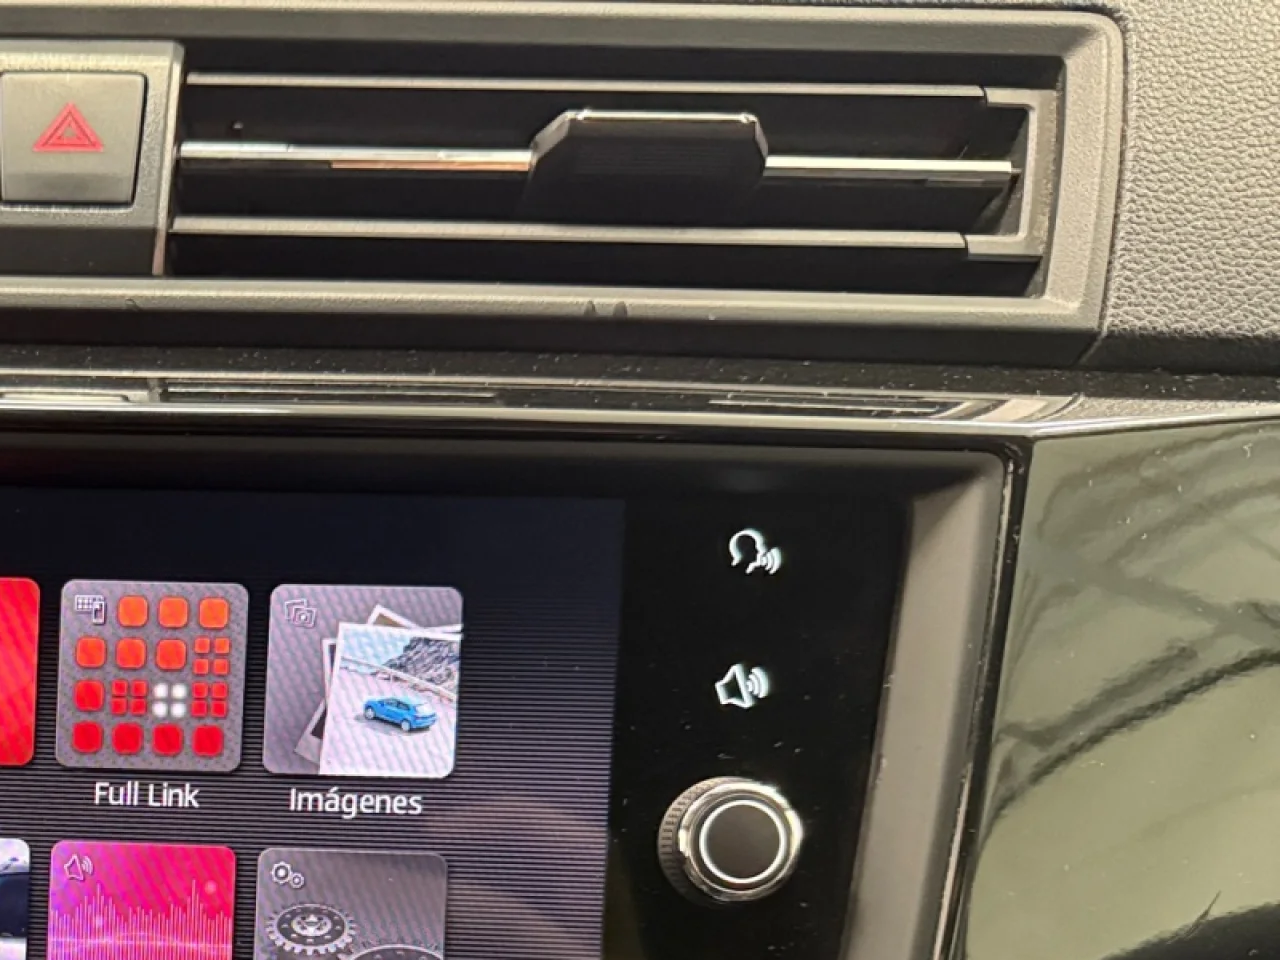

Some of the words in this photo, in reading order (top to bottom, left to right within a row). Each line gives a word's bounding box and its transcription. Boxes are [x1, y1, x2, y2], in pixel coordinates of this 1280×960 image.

[94, 781, 139, 806] Full
[148, 782, 200, 808] Link
[289, 786, 423, 820] Imágenes
